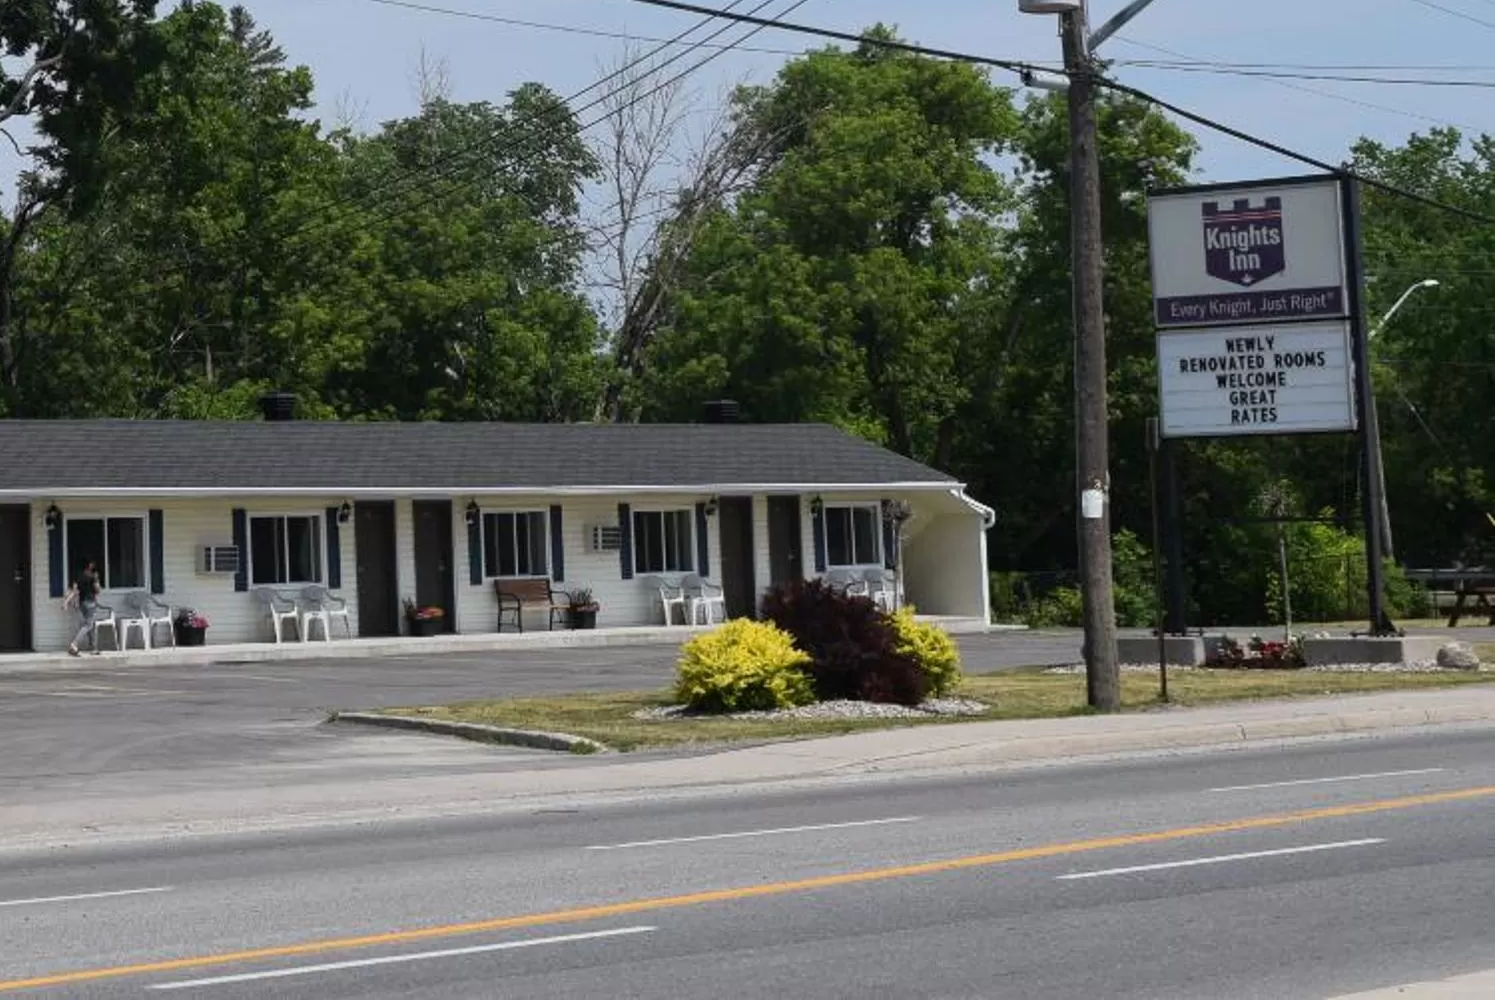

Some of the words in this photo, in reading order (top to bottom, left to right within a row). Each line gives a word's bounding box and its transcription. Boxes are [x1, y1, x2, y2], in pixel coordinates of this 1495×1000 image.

[1206, 224, 1281, 252] Knights
[1229, 249, 1261, 271] Inn
[1170, 302, 1205, 318] Every
[1209, 299, 1257, 317] Knight,
[1260, 296, 1287, 312] Just
[1225, 336, 1275, 353] NEWLY
[1180, 354, 1265, 373] RENOVATED
[1274, 351, 1326, 369] ROOMS
[1216, 371, 1287, 389] WELCOME
[1229, 389, 1277, 405] GREAT
[1231, 407, 1278, 424] RATES
